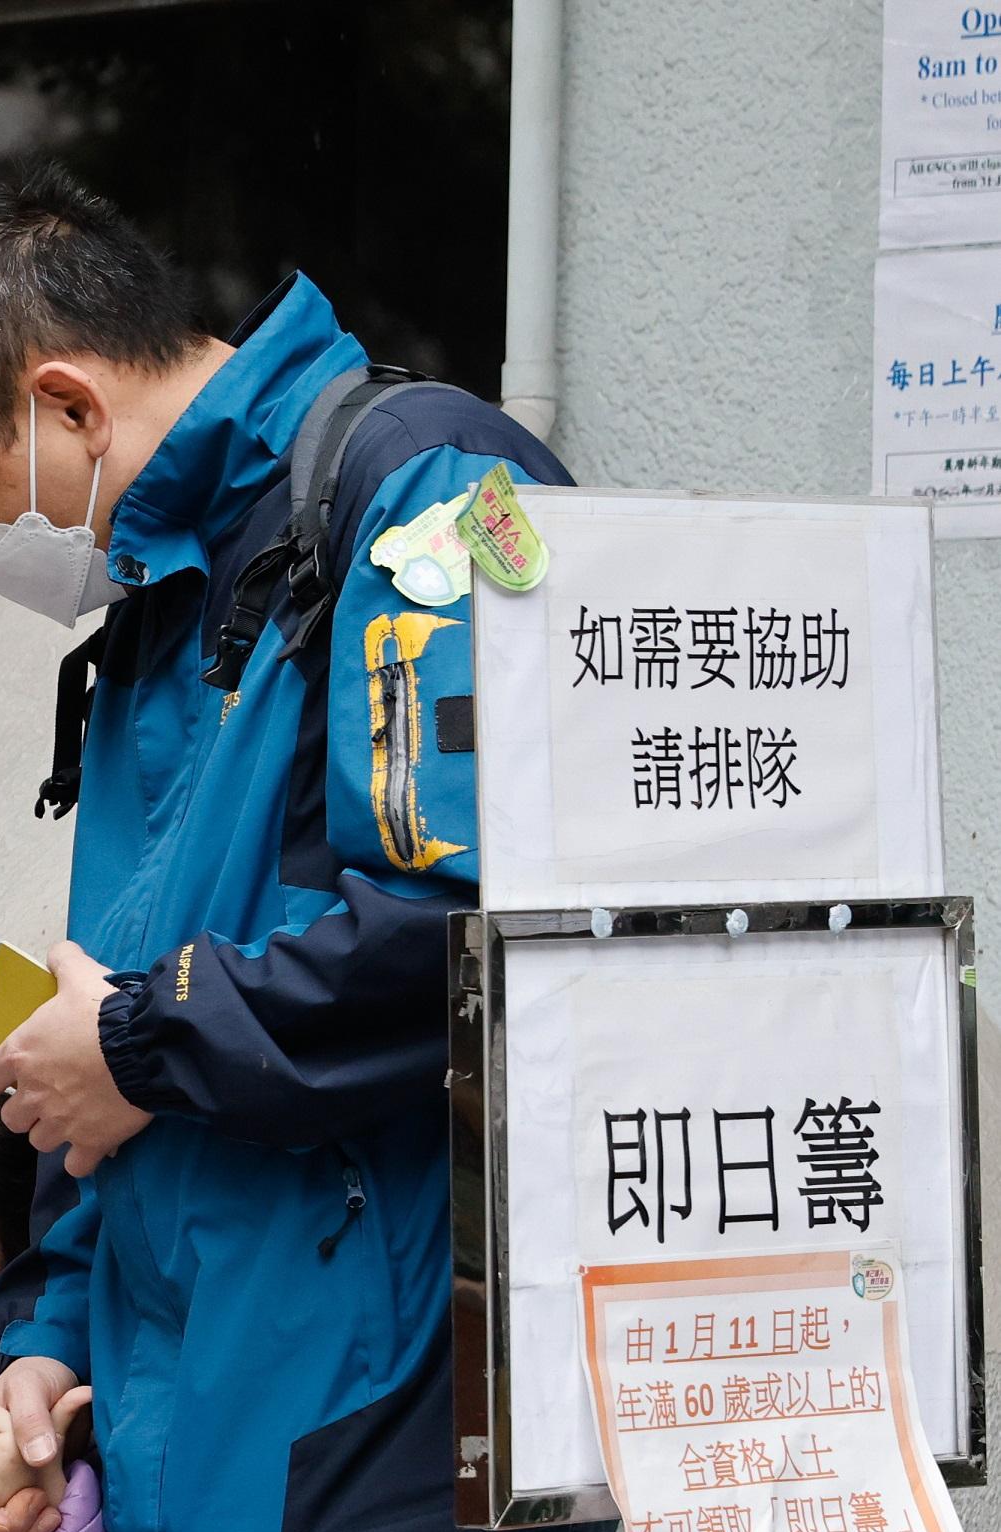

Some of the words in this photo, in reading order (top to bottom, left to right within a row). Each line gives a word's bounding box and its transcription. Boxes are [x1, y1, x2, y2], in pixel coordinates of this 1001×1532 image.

[961, 8, 1001, 37] Op
[918, 56, 966, 80] 8am
[976, 52, 998, 75] to
[932, 88, 978, 109] Closed
[886, 355, 1001, 391] 每日上午
[569, 605, 851, 690] 如需要協助
[631, 726, 802, 811] 請排隊
[603, 1095, 885, 1244] 即日籌
[678, 1433, 836, 1488] 合資格人士
